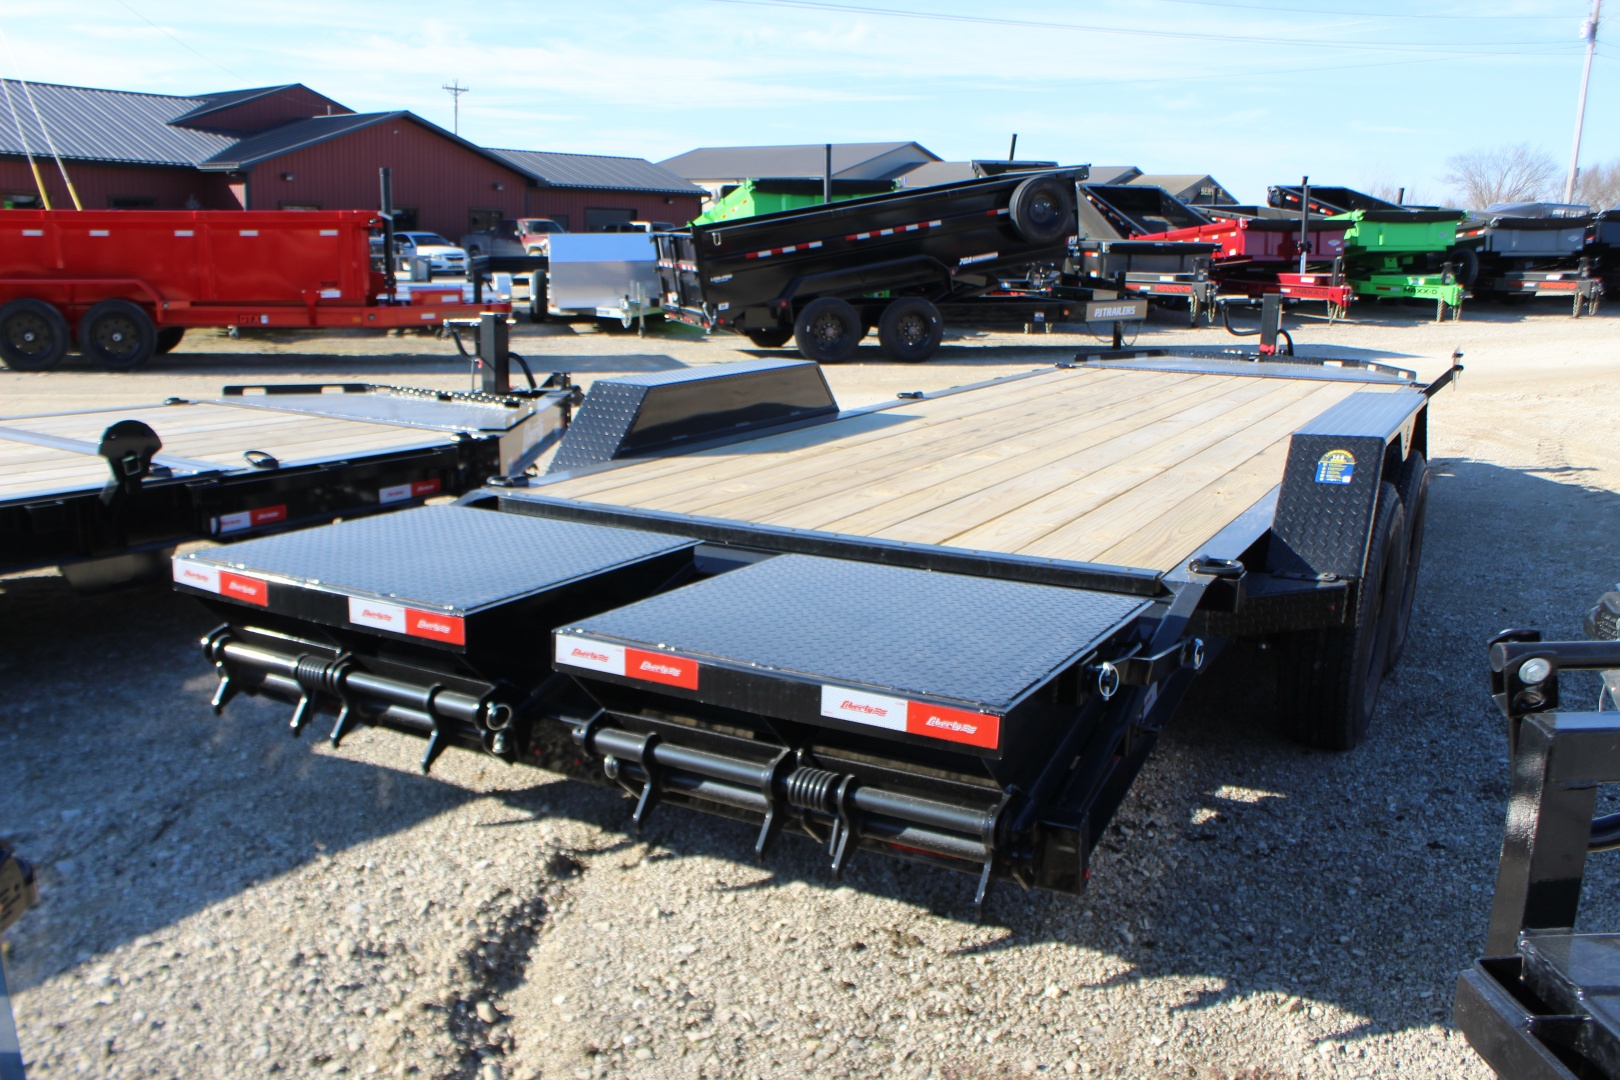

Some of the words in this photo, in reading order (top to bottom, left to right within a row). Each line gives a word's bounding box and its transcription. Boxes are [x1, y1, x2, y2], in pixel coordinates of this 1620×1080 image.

[1154, 284, 1192, 294] MAXX-D
[1293, 288, 1329, 297] MAXX-D
[1403, 286, 1438, 295] MAXX-D
[640, 661, 669, 675] Liberty
[840, 700, 874, 714] Liberty
[925, 716, 962, 731] Liberty
